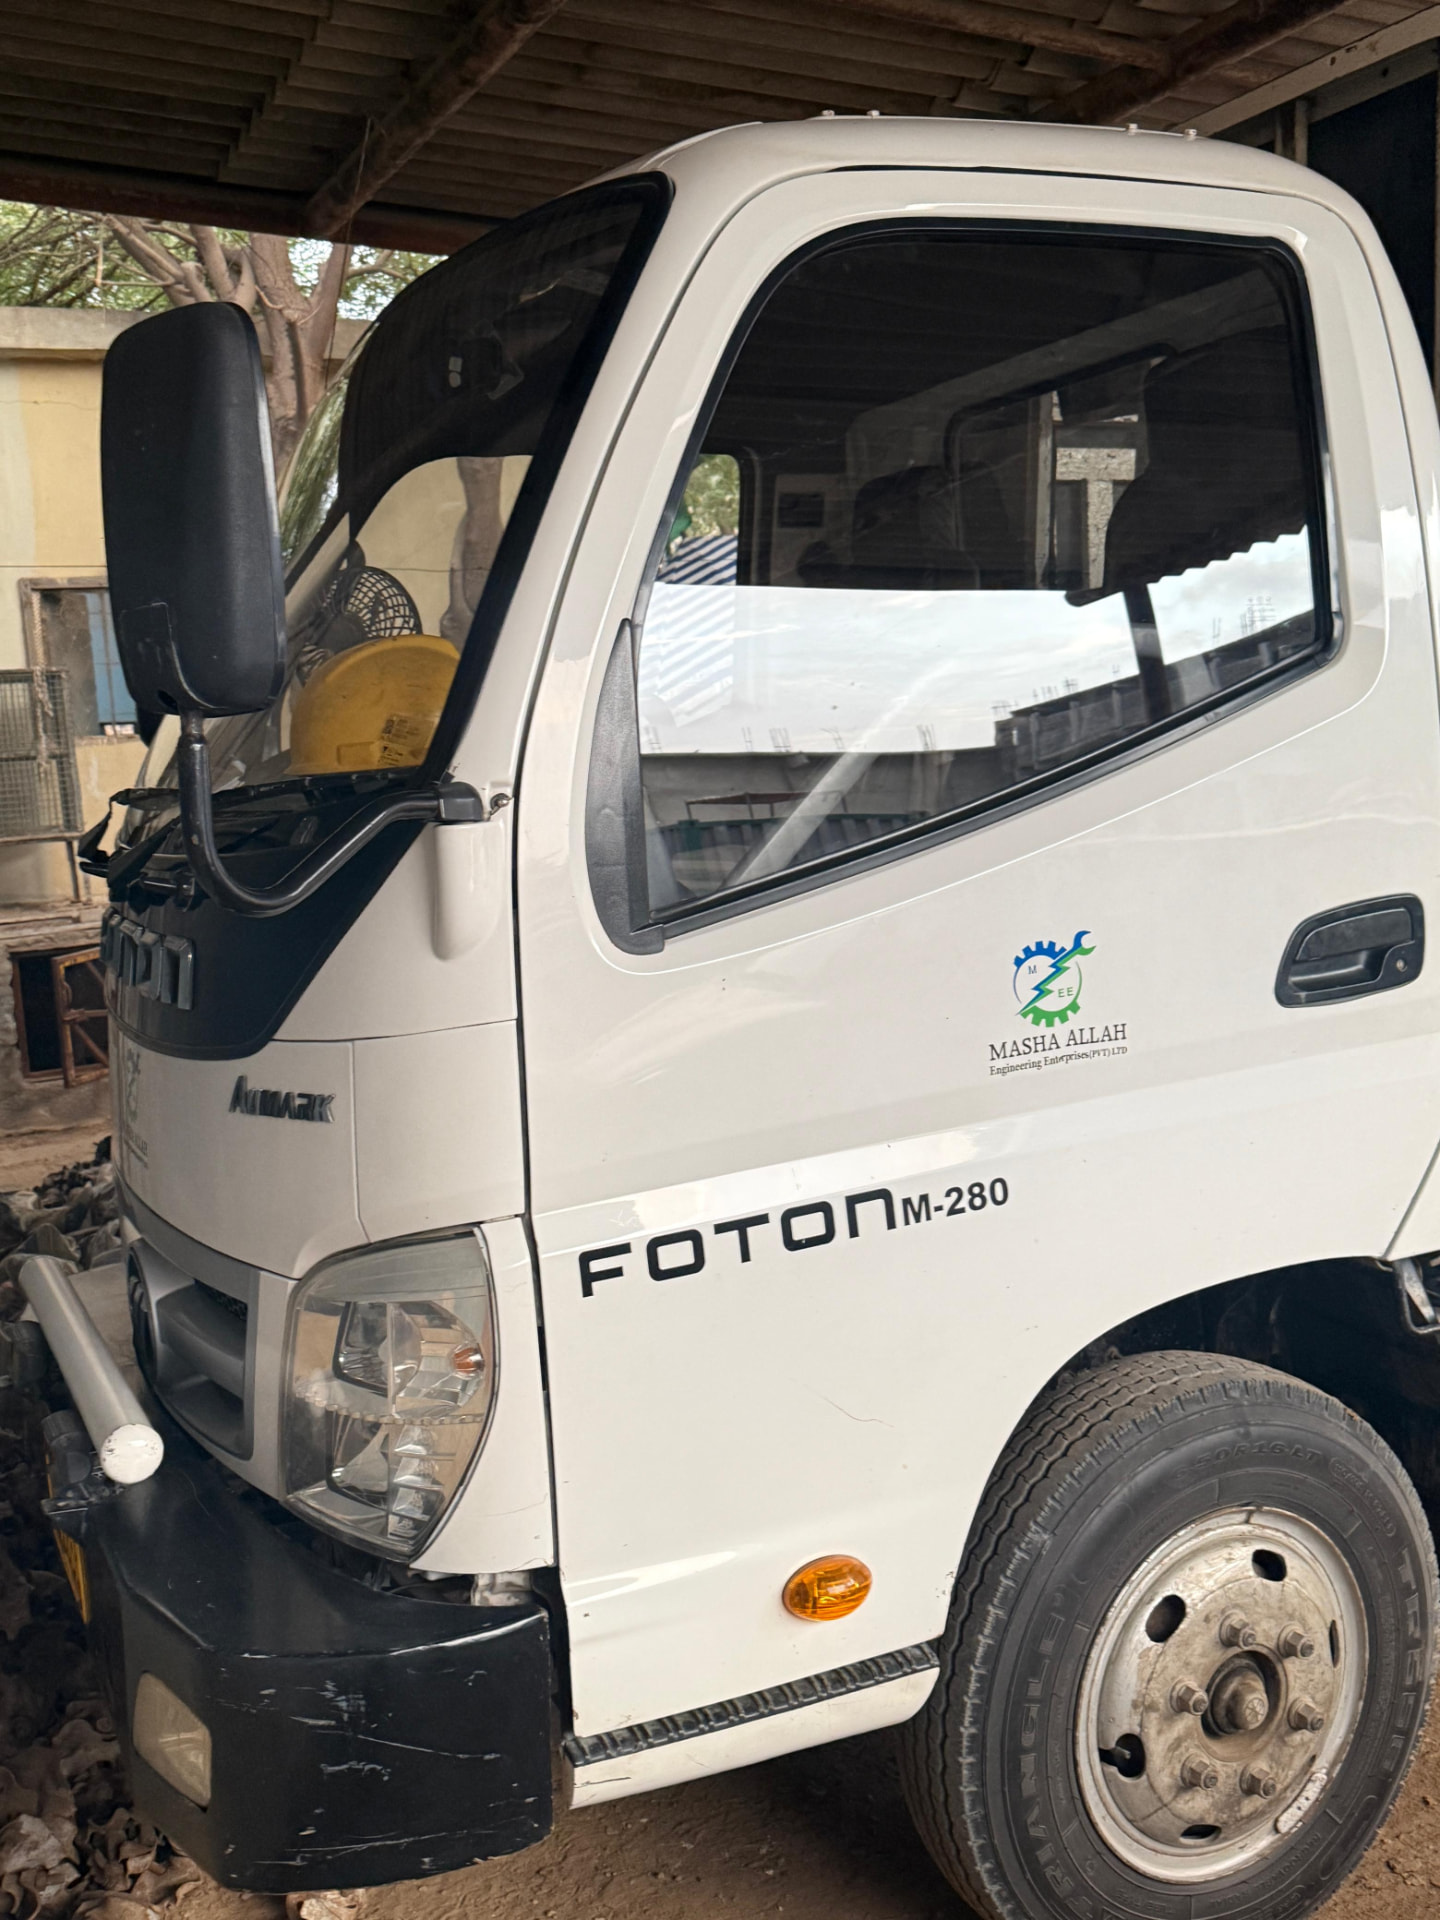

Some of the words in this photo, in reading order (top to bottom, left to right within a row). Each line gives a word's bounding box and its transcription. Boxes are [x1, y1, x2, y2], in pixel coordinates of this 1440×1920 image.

[1028, 965, 1037, 974] M
[989, 1033, 1061, 1061] MASHA
[1066, 1023, 1127, 1047] ALLAH
[989, 1059, 1043, 1077] Engineering
[1112, 1046, 1127, 1055] LTD
[578, 1187, 897, 1298] FOTON
[902, 1177, 1009, 1226] M-280
